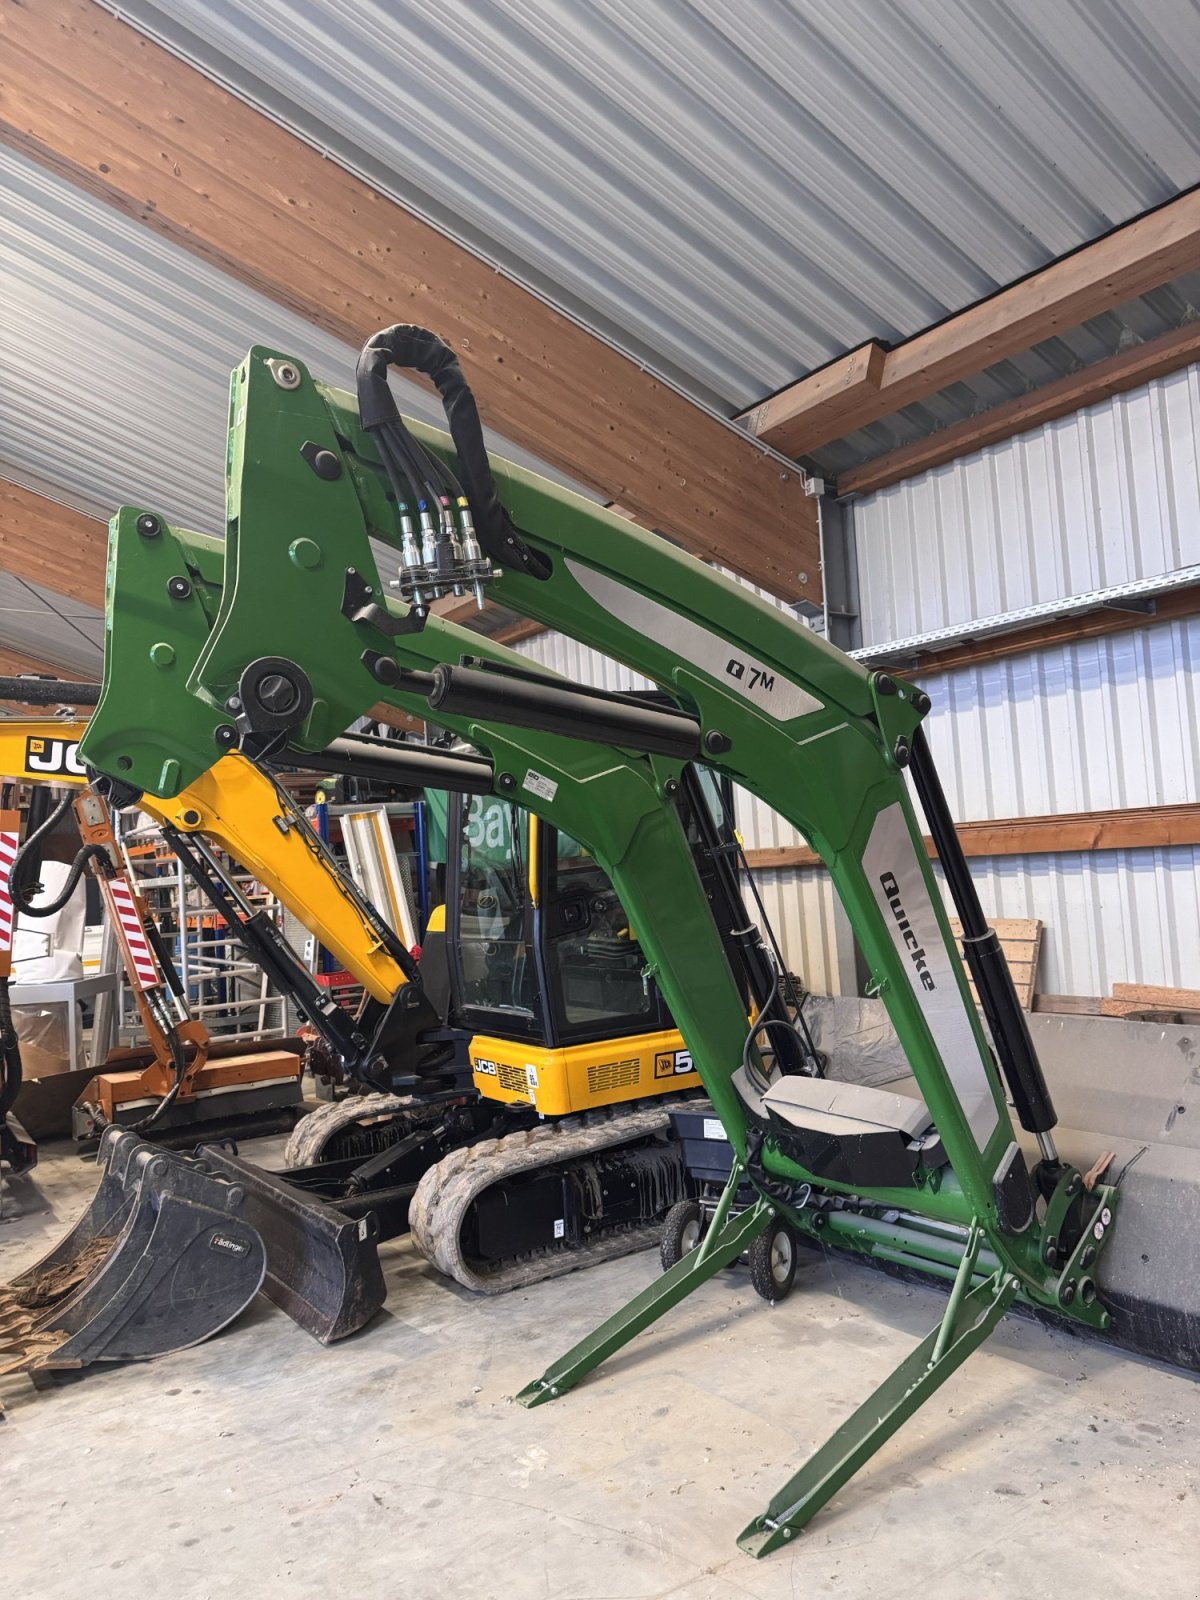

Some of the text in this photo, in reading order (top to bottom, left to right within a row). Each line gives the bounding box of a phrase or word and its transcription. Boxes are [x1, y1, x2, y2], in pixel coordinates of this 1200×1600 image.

[726, 659, 746, 681] Q
[28, 741, 87, 774] JC
[463, 794, 527, 859] Bay
[880, 871, 936, 992] Quicke
[475, 1058, 497, 1076] JCB
[674, 1050, 697, 1074] 5
